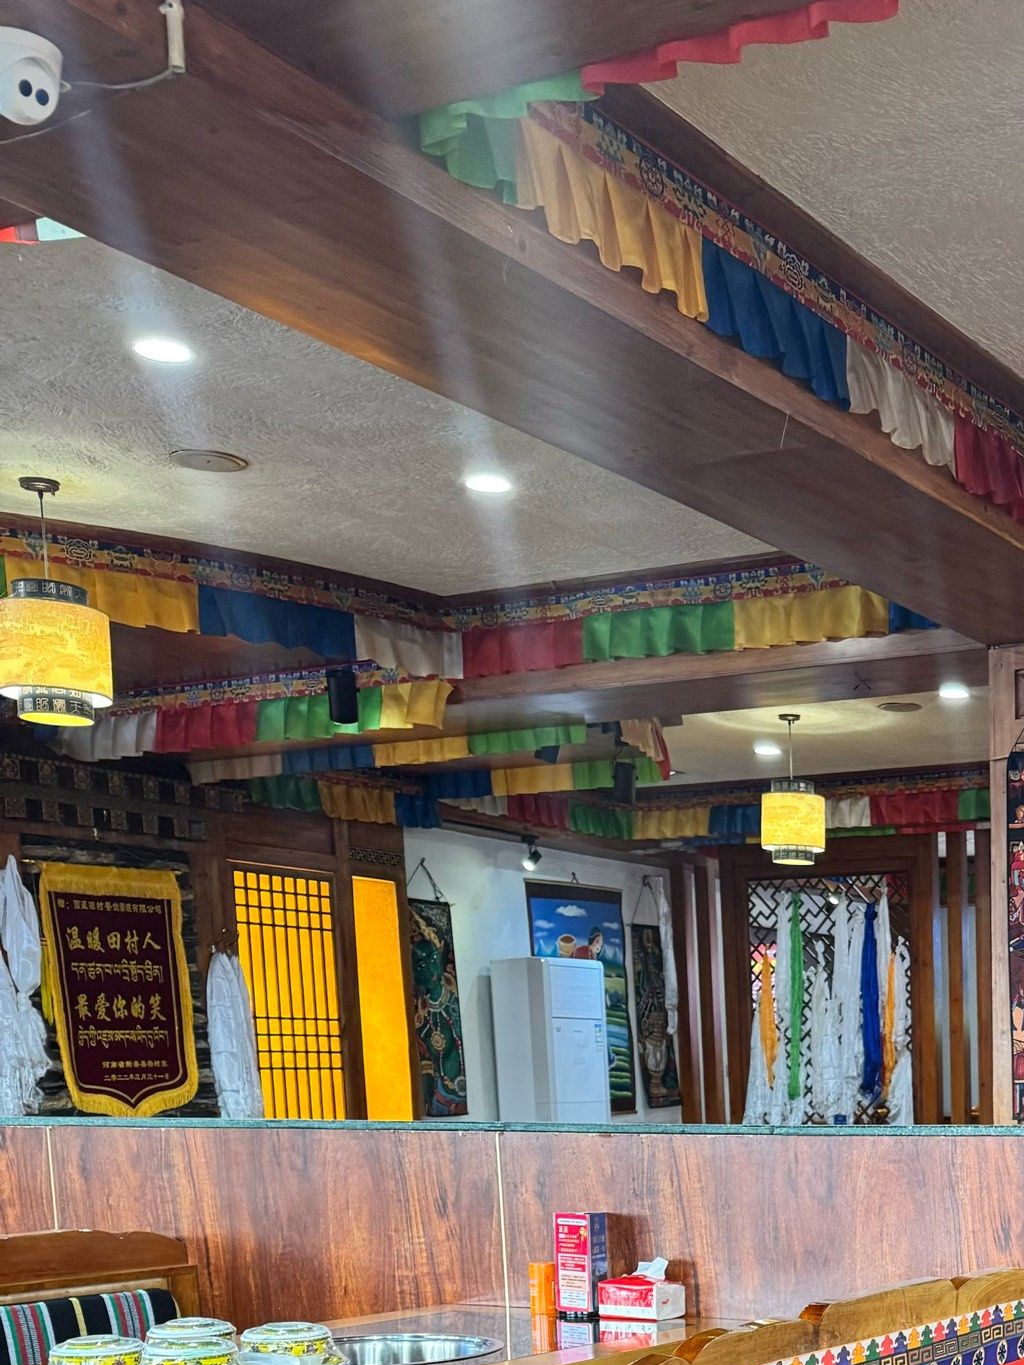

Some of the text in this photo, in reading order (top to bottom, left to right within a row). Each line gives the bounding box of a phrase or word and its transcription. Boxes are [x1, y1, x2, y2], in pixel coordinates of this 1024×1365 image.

[65, 926, 161, 955] 温暖田村人
[75, 993, 167, 1021] 最爱你的笑
